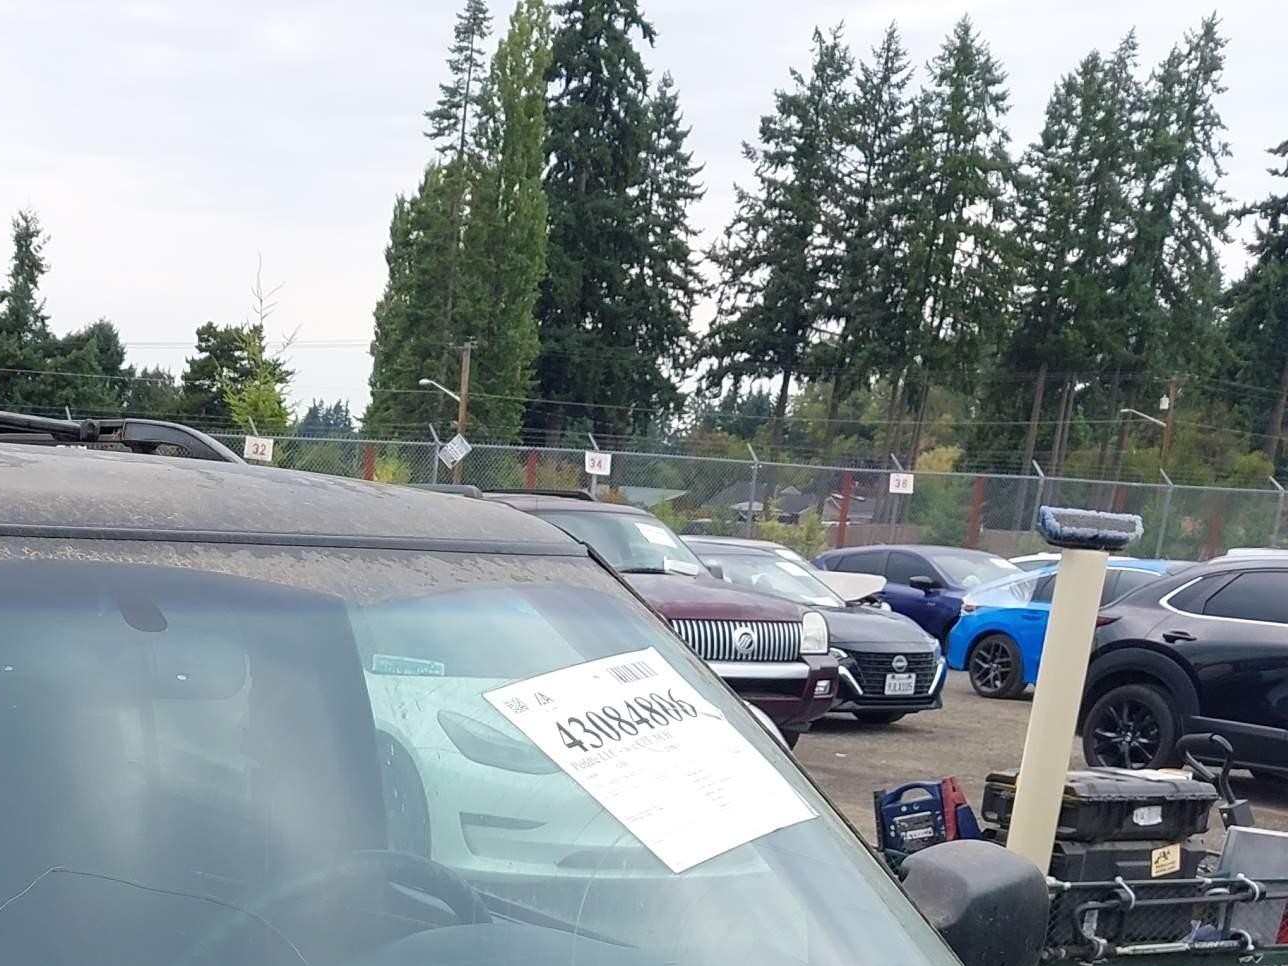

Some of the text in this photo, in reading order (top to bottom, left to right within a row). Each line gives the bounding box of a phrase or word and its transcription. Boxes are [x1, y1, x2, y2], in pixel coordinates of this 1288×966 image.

[252, 443, 266, 456] 32
[590, 458, 602, 470] 34
[556, 689, 697, 752] 43084806
